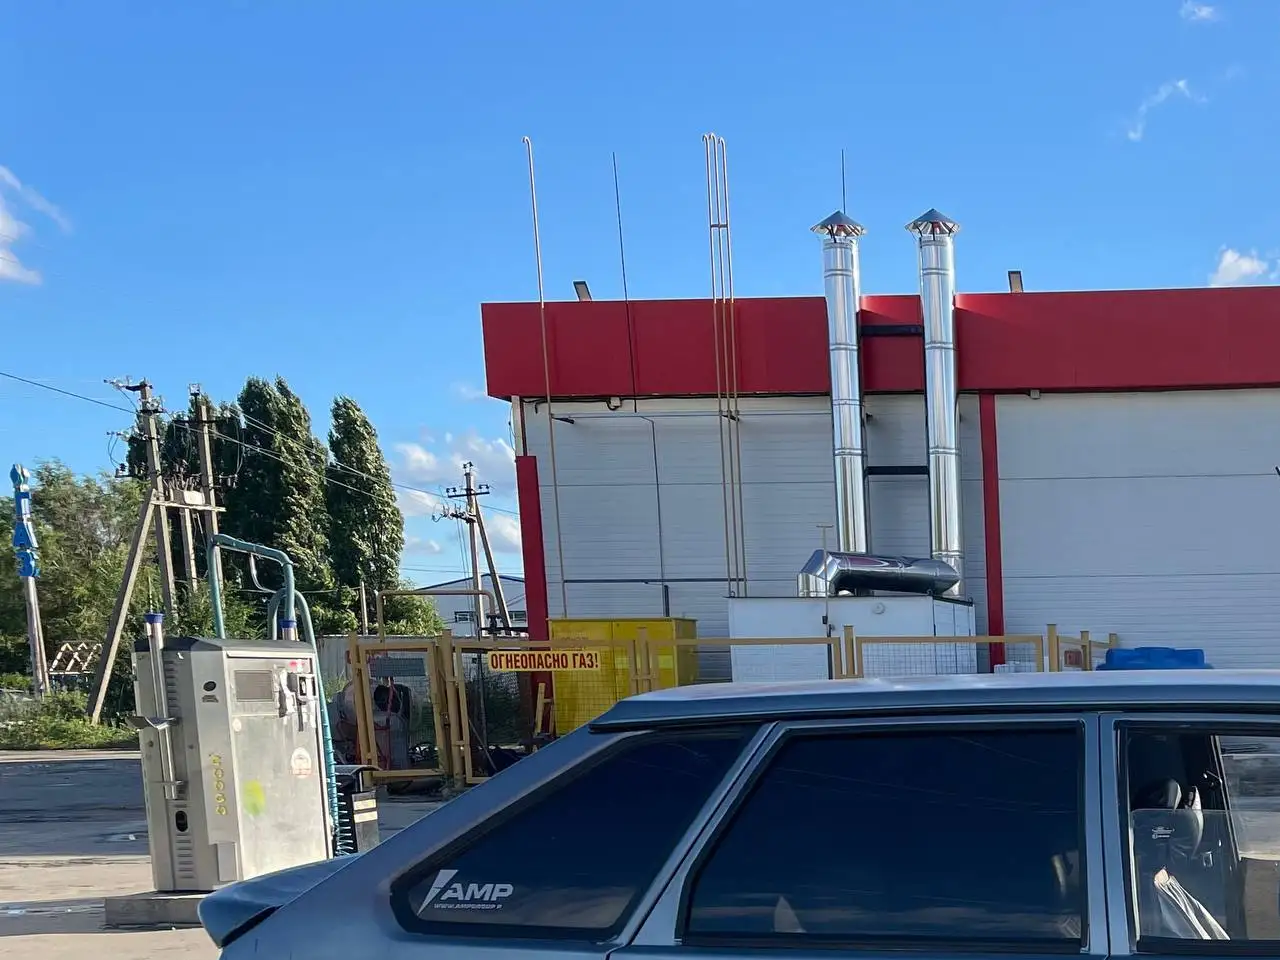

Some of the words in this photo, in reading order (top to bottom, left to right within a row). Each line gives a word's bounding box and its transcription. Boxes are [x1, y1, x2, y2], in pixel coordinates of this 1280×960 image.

[491, 653, 568, 669] ОГНЕОПАСНО
[572, 653, 599, 669] ГАЗ!
[440, 883, 514, 901] AMP
